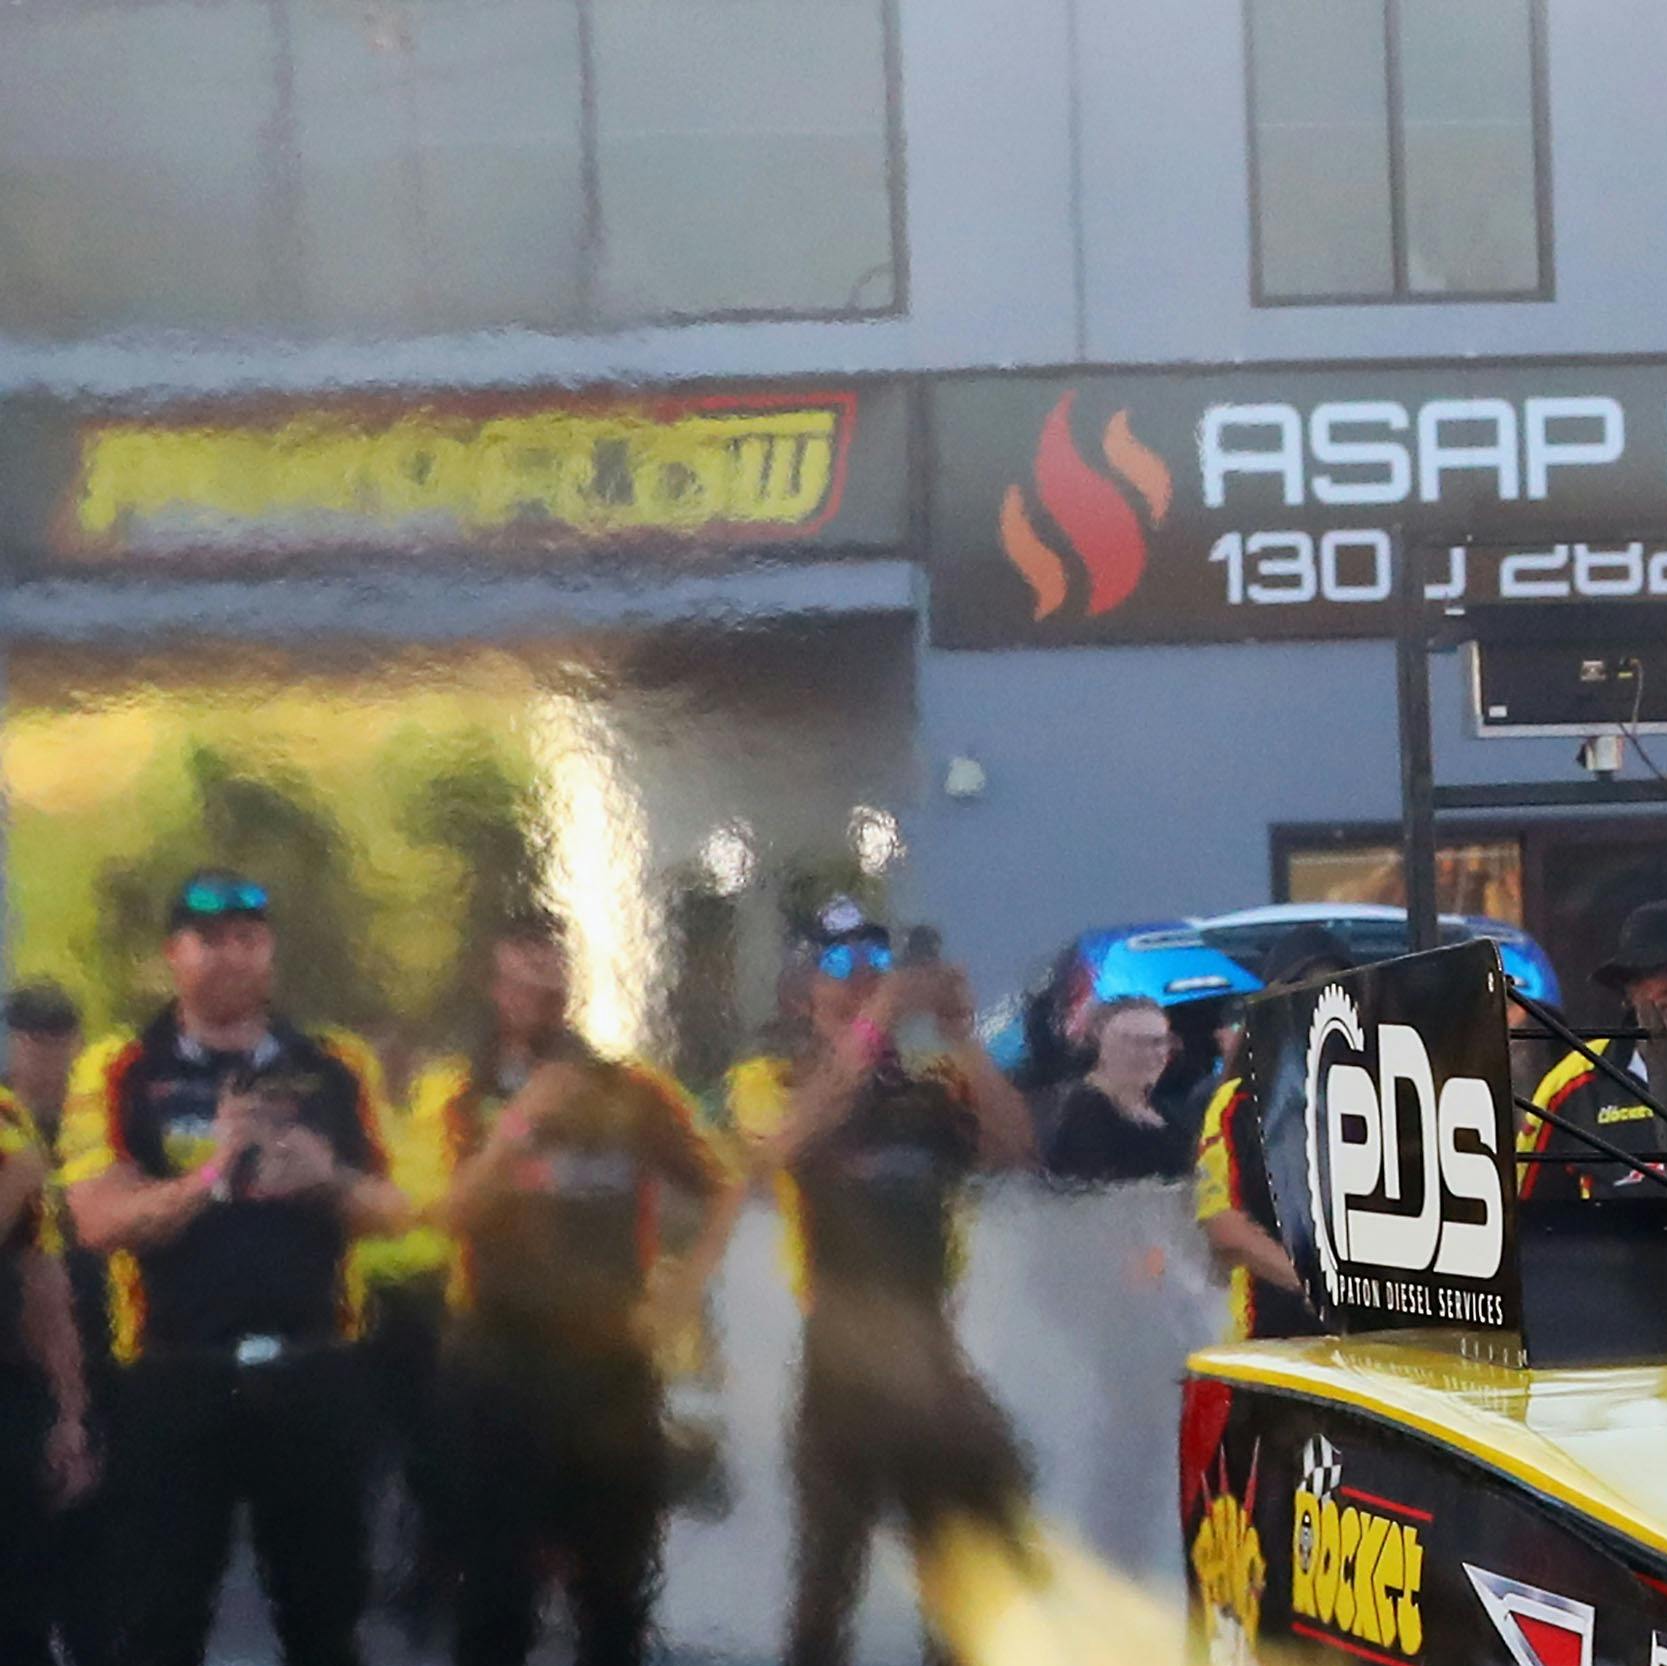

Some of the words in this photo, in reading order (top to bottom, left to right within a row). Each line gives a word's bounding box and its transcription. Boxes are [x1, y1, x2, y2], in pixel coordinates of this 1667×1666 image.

[1202, 399, 1625, 508] ASAP
[1326, 1023, 1503, 1279] PDS
[1339, 1274, 1381, 1308] PATON
[1386, 1281, 1432, 1316] DIESEL
[1438, 1288, 1503, 1325] SERVICES
